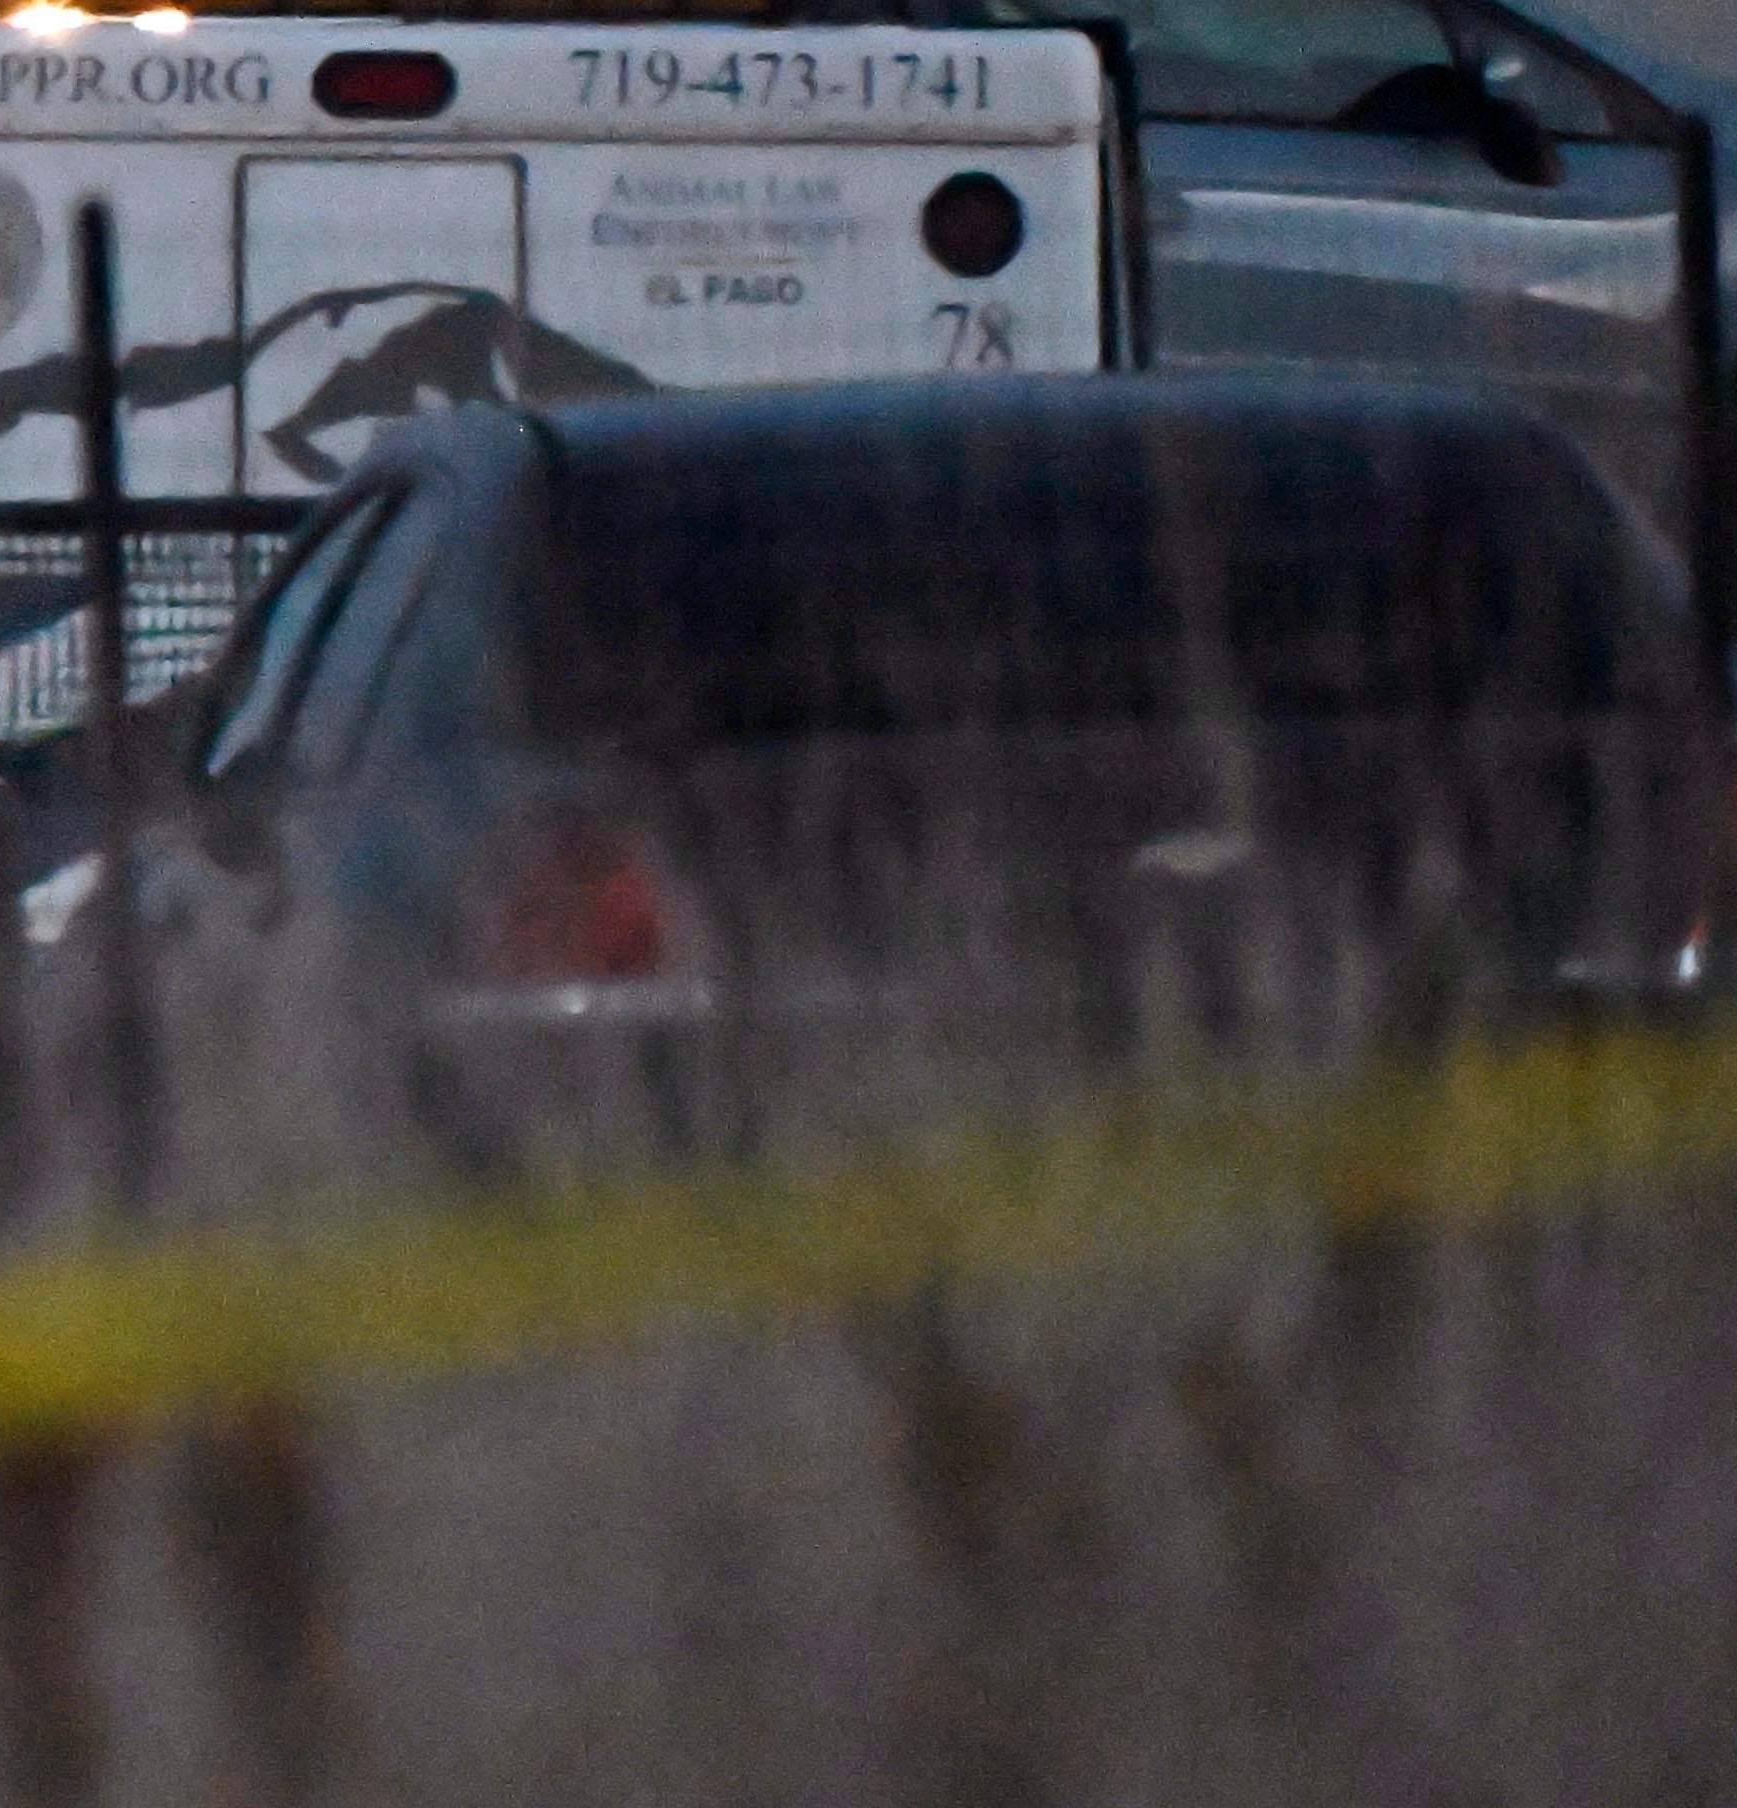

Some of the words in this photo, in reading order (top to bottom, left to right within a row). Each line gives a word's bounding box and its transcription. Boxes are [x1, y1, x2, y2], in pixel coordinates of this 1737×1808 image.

[569, 49, 991, 110] 719-473-1741
[701, 274, 804, 306] PASO
[931, 304, 1017, 372] 78
